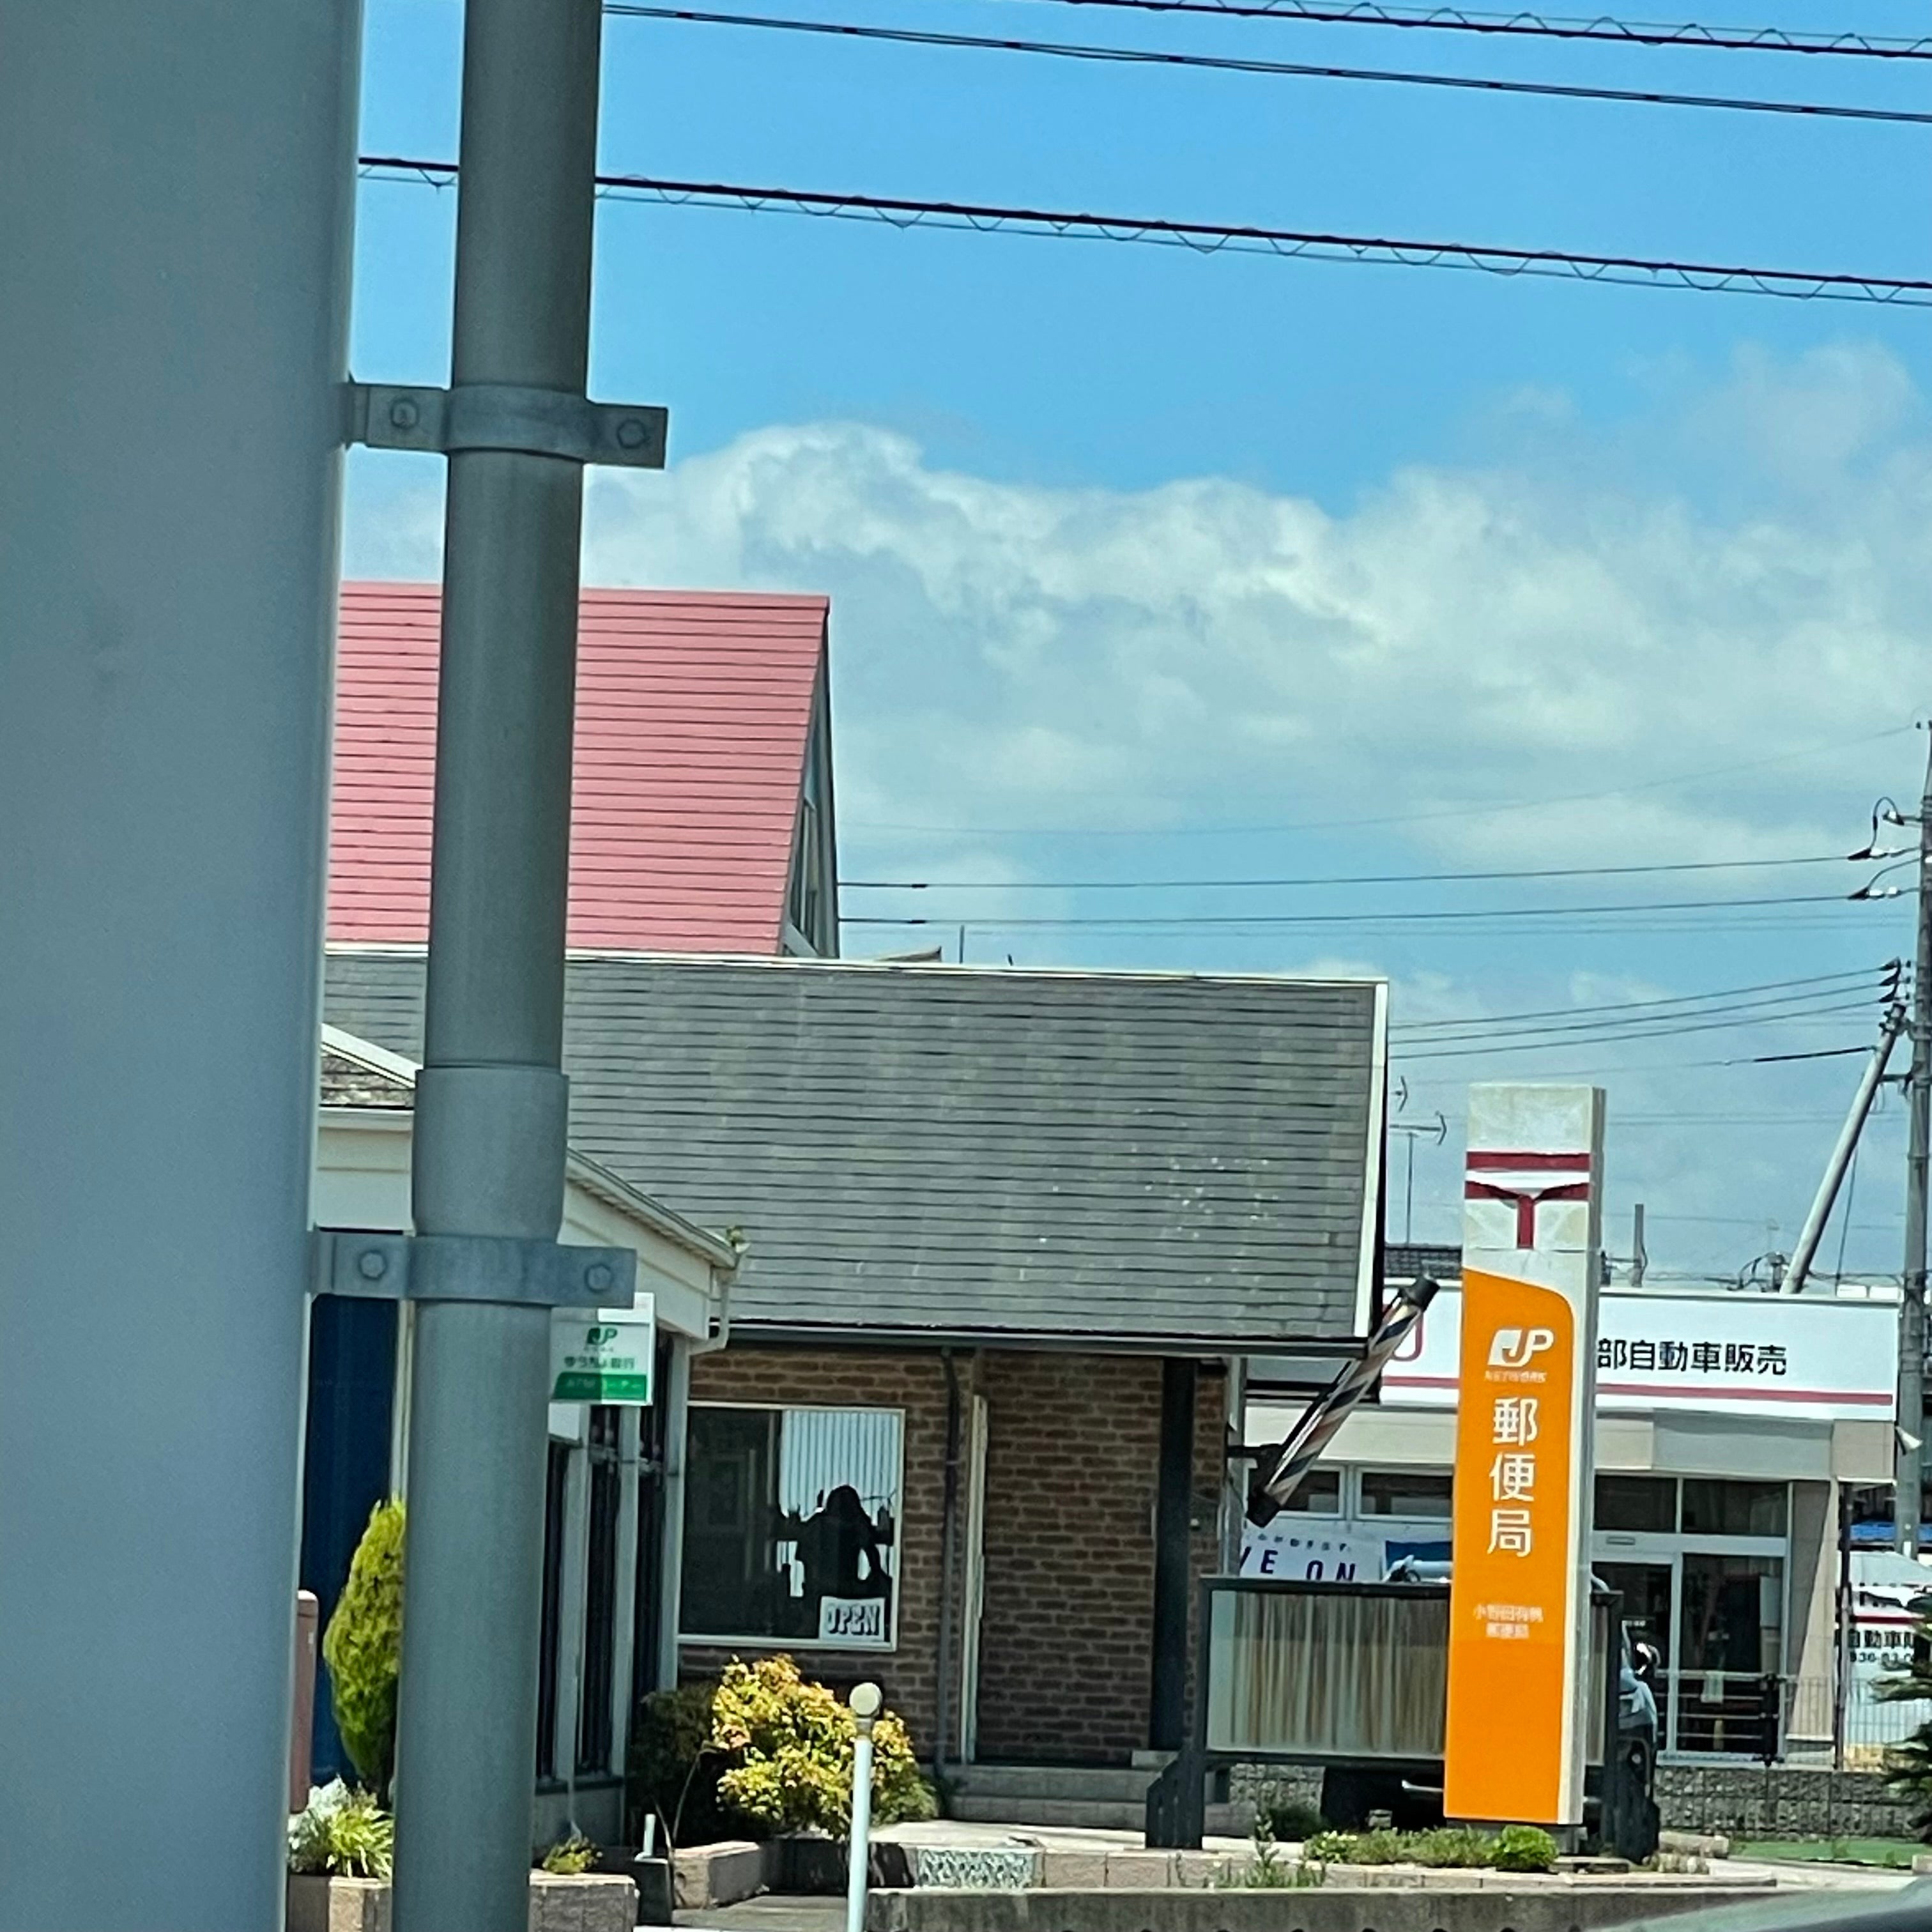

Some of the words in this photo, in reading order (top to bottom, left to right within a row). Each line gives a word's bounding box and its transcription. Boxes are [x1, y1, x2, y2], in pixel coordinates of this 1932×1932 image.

[586, 1327, 617, 1346] JP
[1487, 1329, 1554, 1367] JP
[1597, 1338, 1787, 1375] 部自動車販売
[1487, 1397, 1538, 1558] 郵便局
[825, 1602, 880, 1636] OPEN
